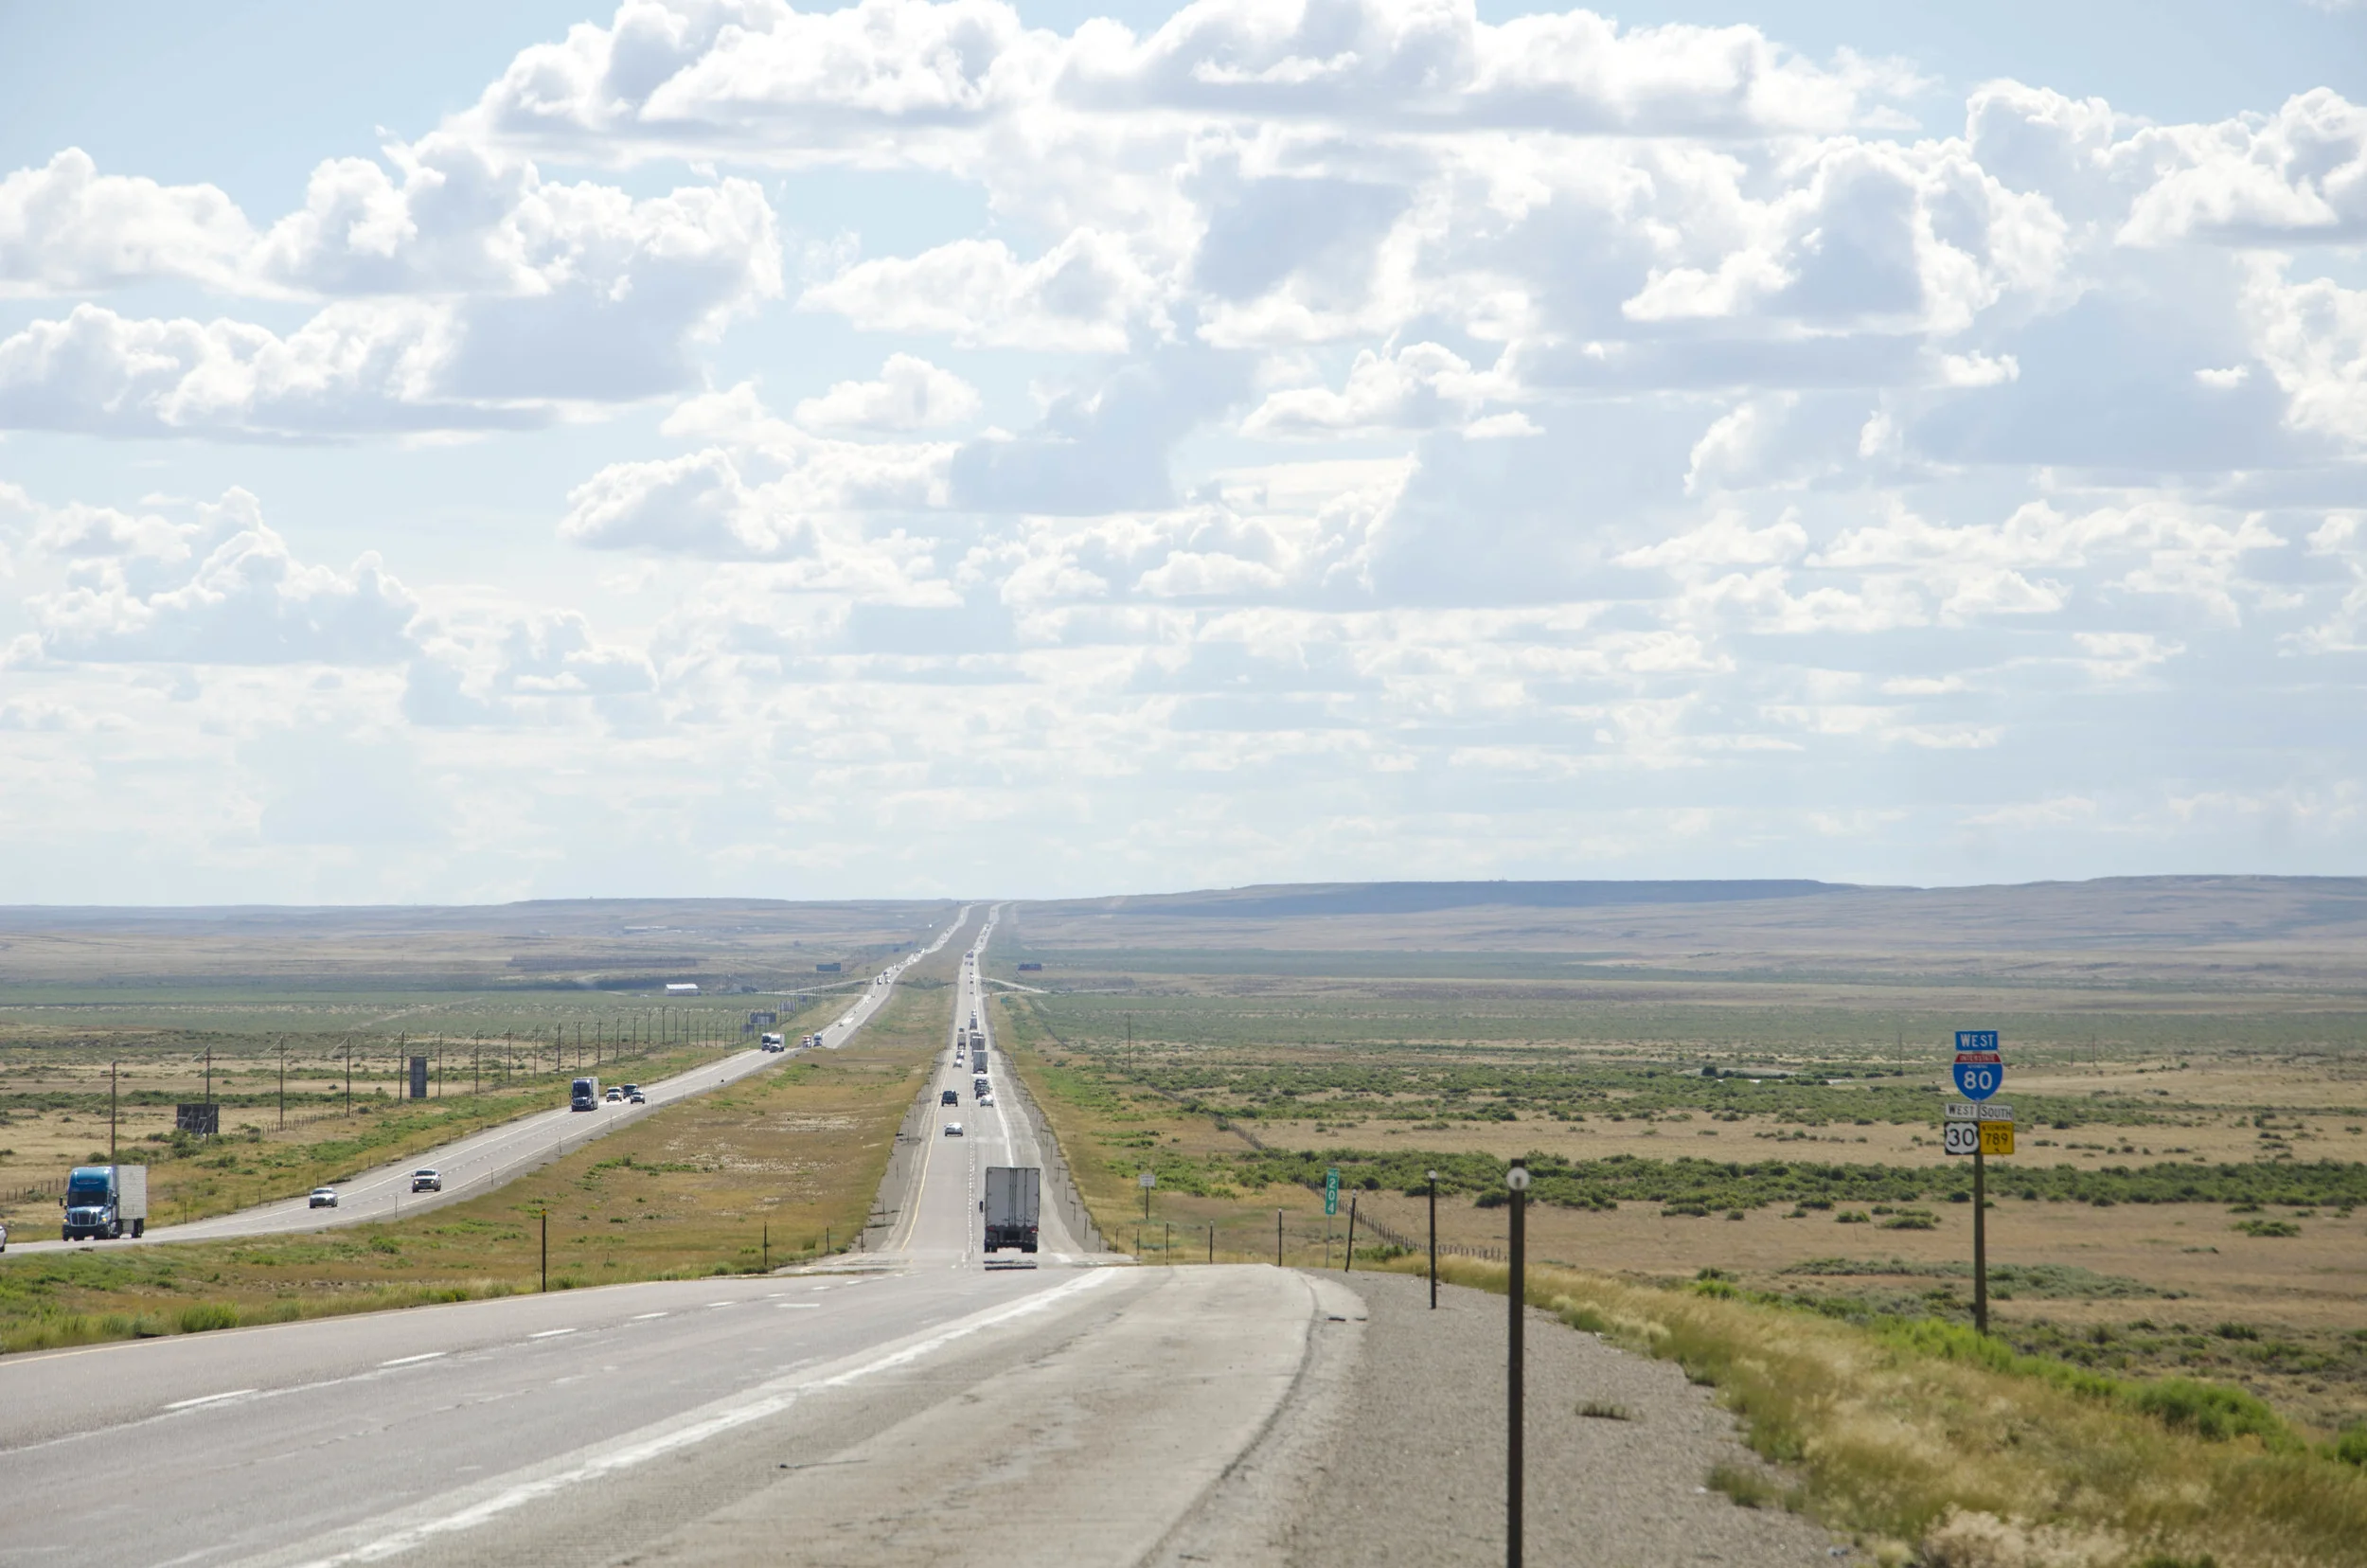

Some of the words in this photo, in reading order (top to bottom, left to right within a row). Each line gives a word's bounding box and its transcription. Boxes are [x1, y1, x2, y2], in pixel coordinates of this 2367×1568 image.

[1960, 1034, 1994, 1047] WEST
[1964, 1071, 1992, 1090] 80
[1949, 1104, 1974, 1115] WEST
[1981, 1106, 2011, 1118] SOUTH
[1949, 1128, 1975, 1147] 30
[1984, 1132, 2008, 1146] 789
[1327, 1177, 1336, 1213] 204
